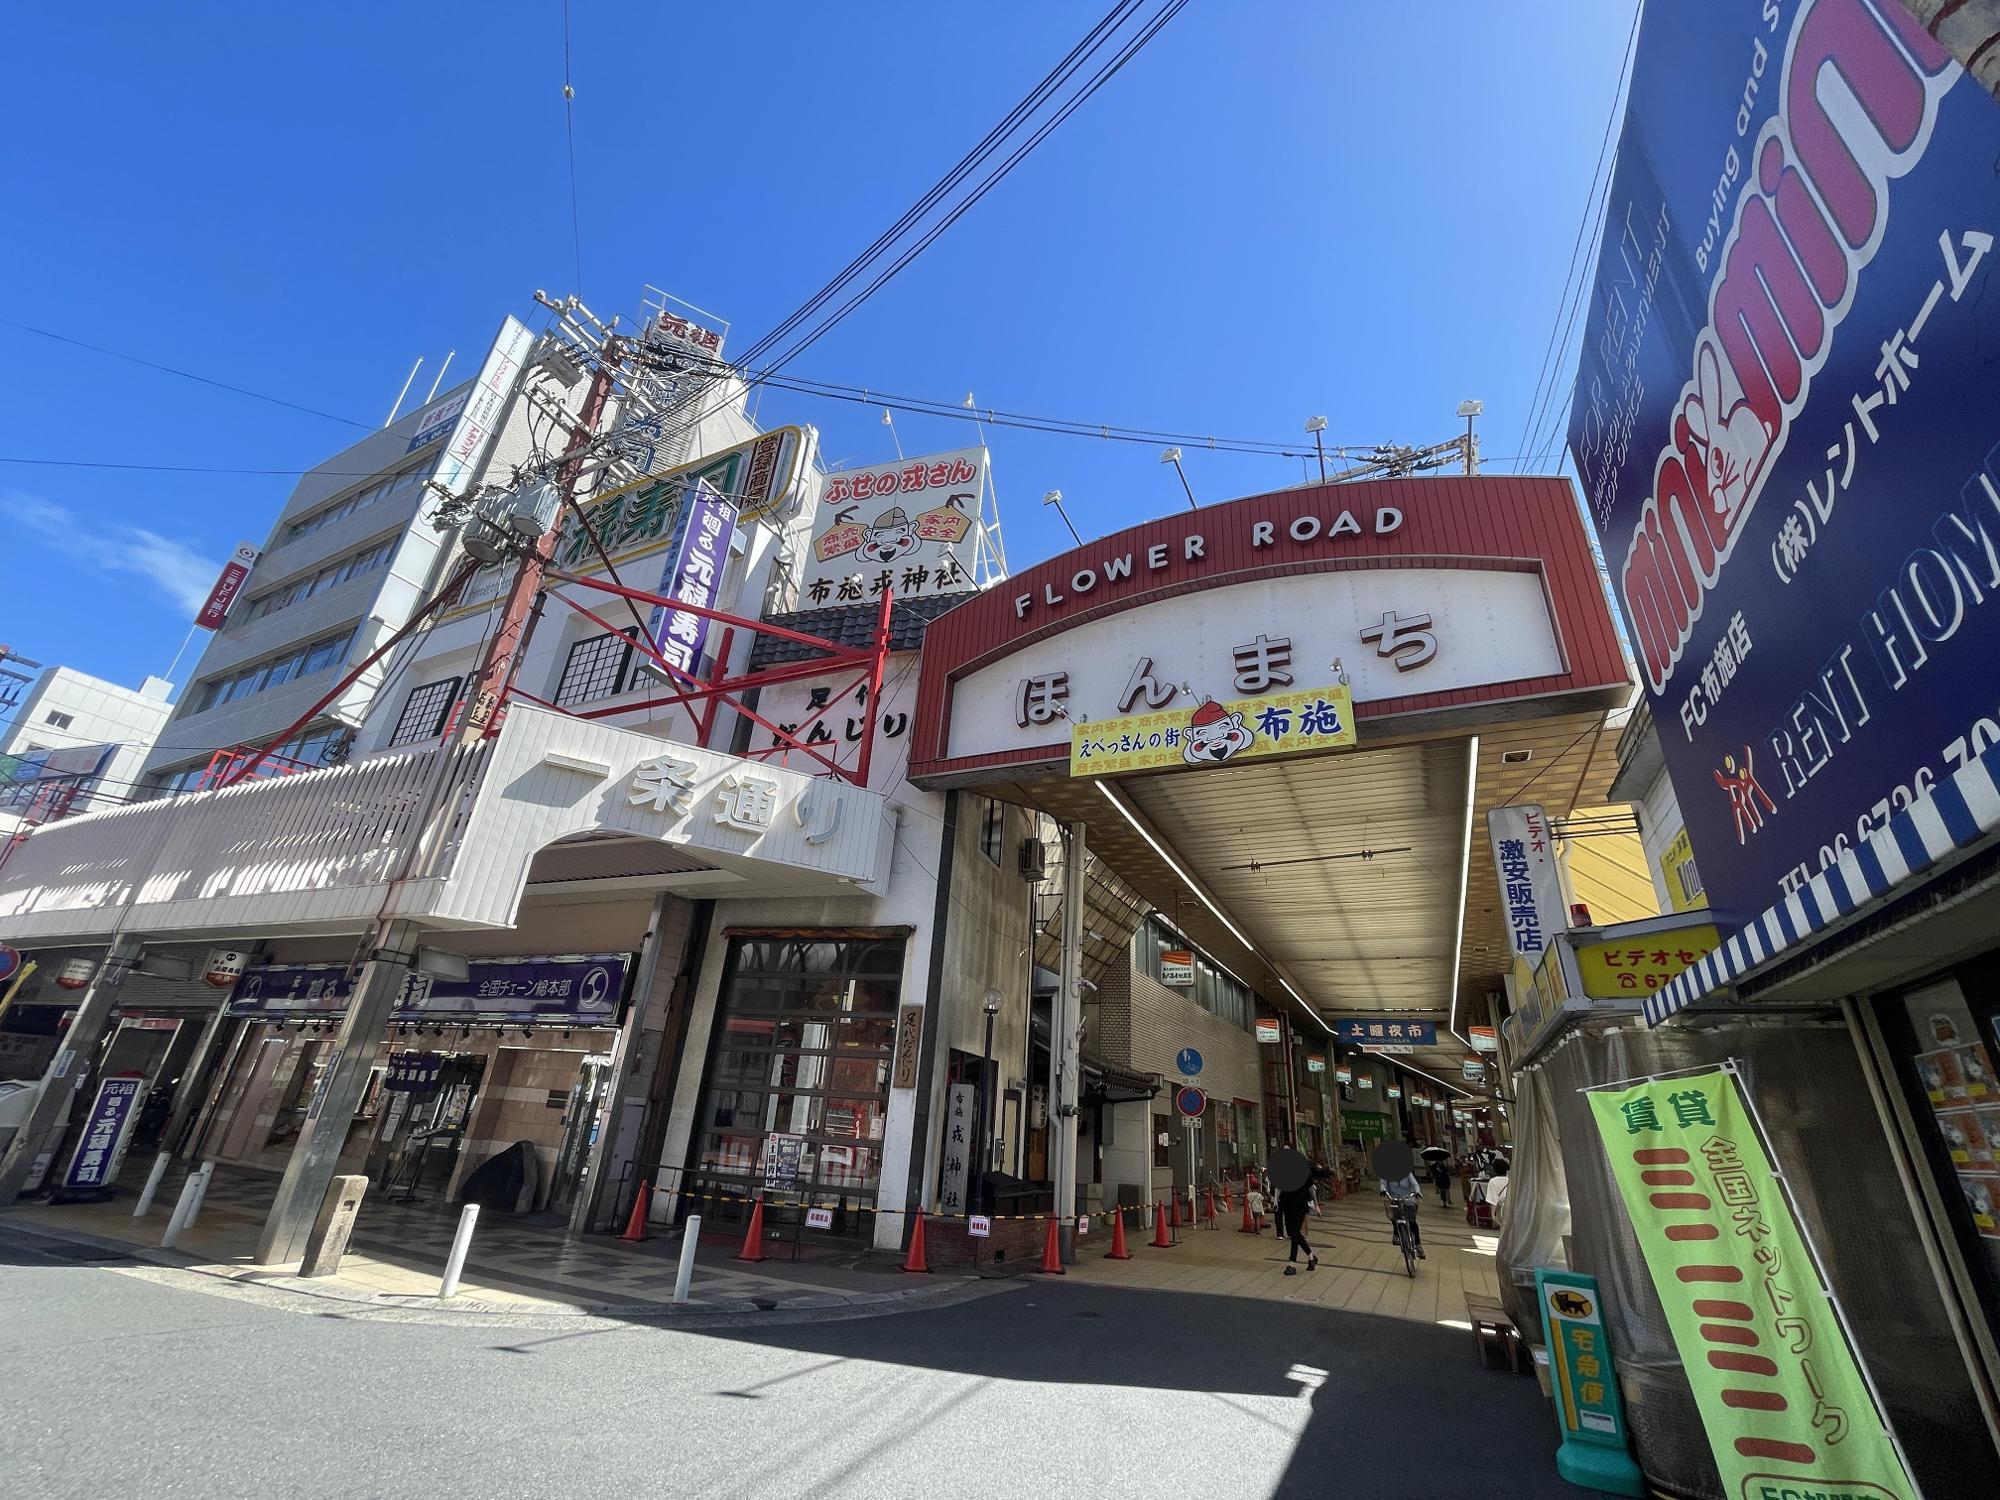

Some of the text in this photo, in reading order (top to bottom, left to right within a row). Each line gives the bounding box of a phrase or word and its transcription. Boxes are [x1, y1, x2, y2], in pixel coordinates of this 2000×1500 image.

[1696, 144, 1740, 274] Buying
[1736, 37, 1768, 137] and
[824, 458, 976, 503] ふせの戎さん
[703, 488, 732, 523] 元祖
[925, 515, 960, 527] 家内
[921, 527, 956, 538] 安全
[807, 563, 962, 605] 布施戎神社
[1015, 505, 1404, 618] FLOWER ROAD
[1766, 438, 2000, 800] RENT HOM
[1015, 610, 1438, 729] ほんまち
[1080, 699, 1343, 758] えべっさんの街 布施
[543, 752, 845, 847] 一条通り
[1499, 838, 1544, 952] 激安販売店
[1603, 949, 1709, 967] ビデオセ
[477, 978, 572, 998] 全国チェーン総本部
[1350, 1023, 1423, 1038] 土曜夜市
[104, 1083, 135, 1095] 元祖
[1620, 1089, 1716, 1136] 賃貸
[1700, 1134, 1851, 1446] 全国ネットワーク
[1571, 1328, 1605, 1405] 宅急便
